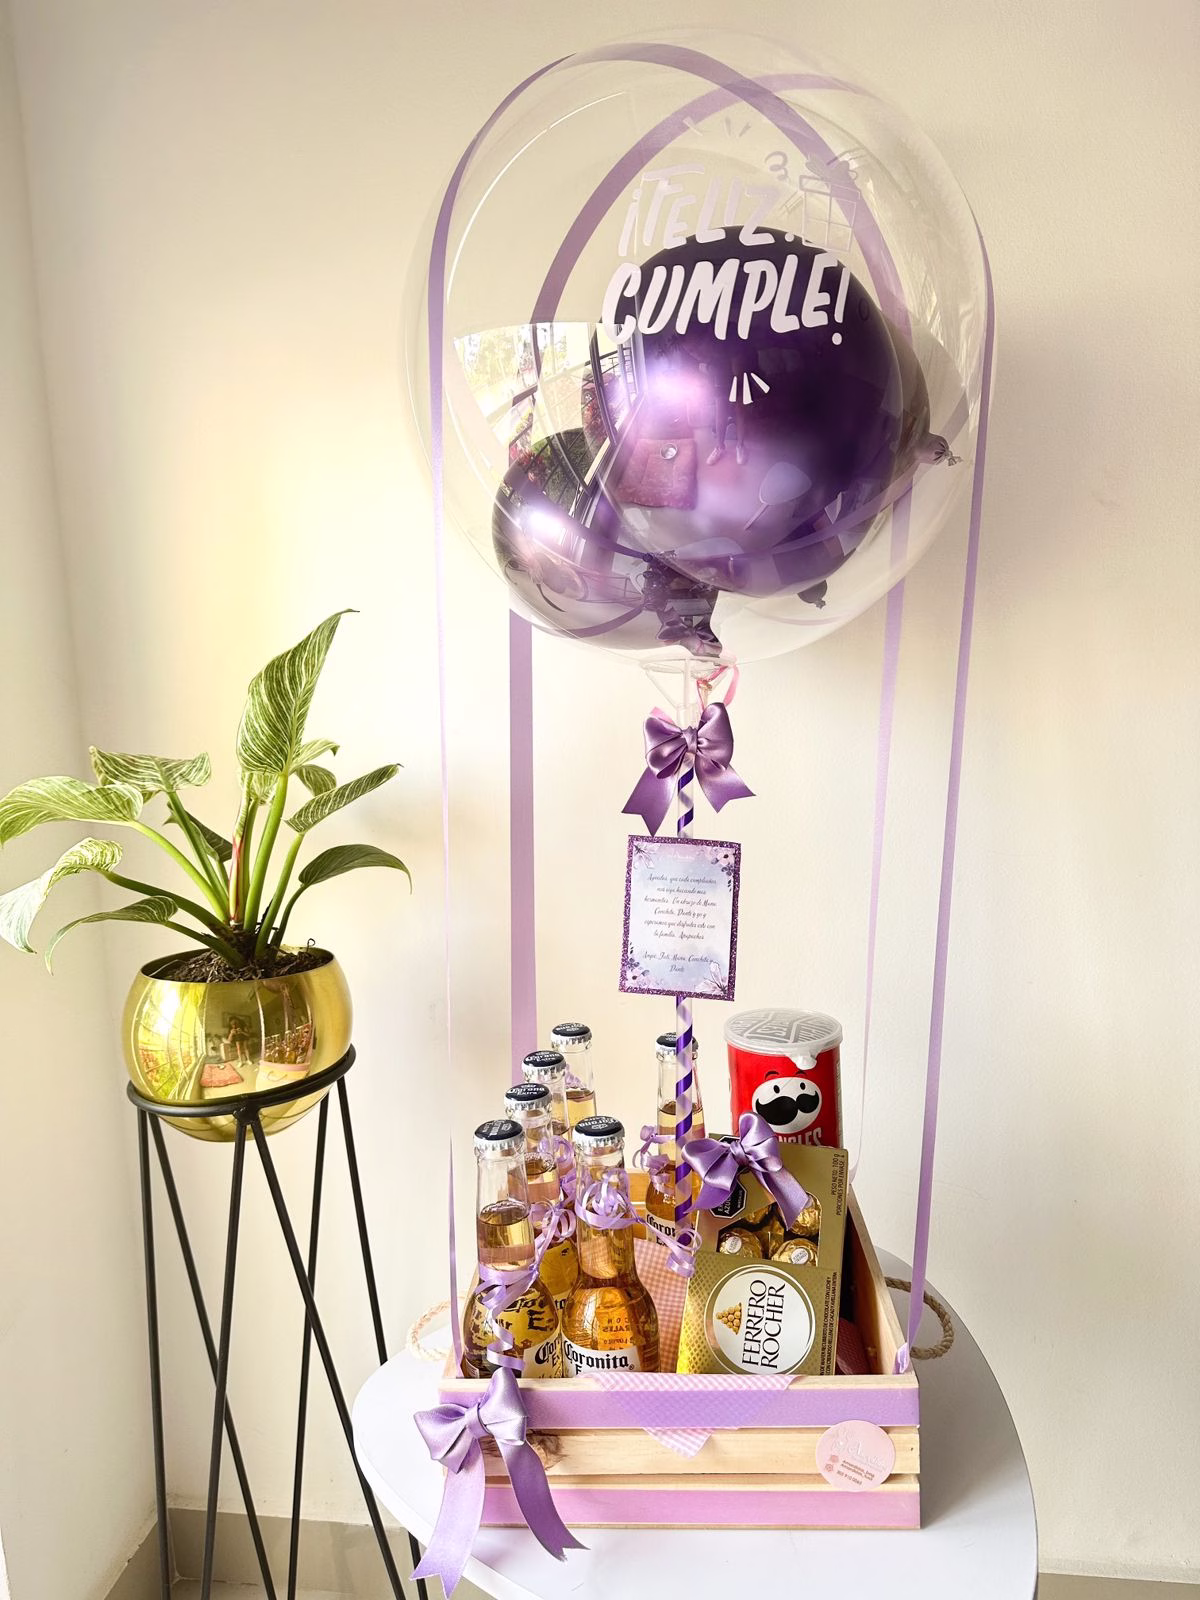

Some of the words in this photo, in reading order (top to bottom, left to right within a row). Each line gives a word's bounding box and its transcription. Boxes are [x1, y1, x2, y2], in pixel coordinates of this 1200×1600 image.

[601, 251, 850, 345] CUMPLE!
[564, 1340, 629, 1369] Coronita
[742, 1280, 767, 1366] FERRERO
[760, 1283, 786, 1369] ROCHER
